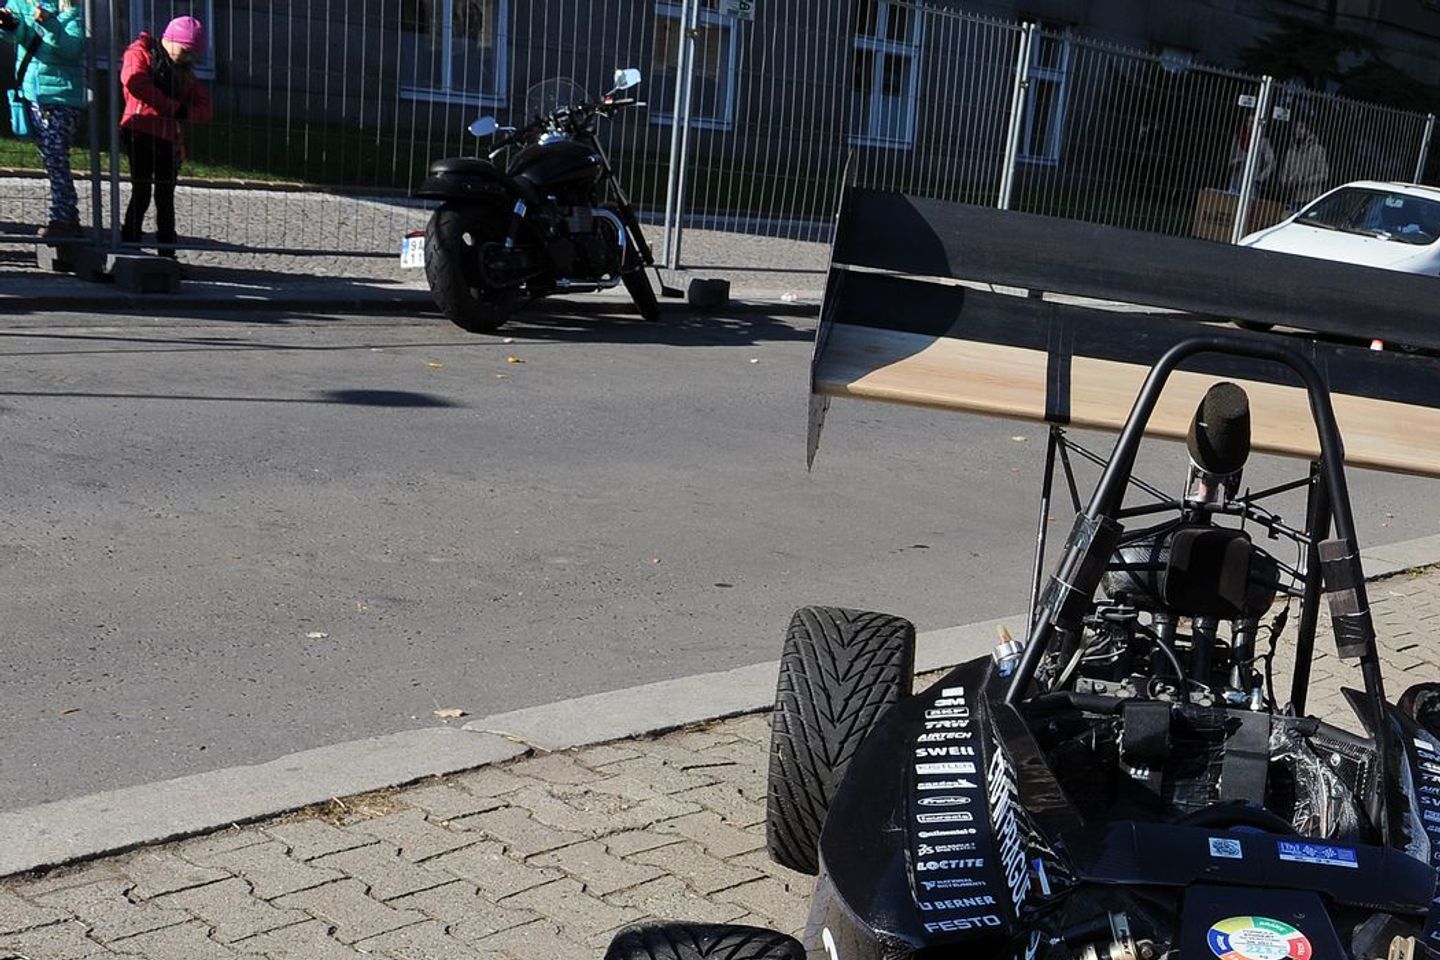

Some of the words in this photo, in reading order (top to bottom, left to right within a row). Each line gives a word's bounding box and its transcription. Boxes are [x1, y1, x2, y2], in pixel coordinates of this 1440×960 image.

[924, 720, 970, 729] TRW
[917, 732, 973, 742] AIRTECH
[917, 858, 984, 871] LOCTITE
[996, 809, 1030, 918] PRAGUE
[934, 895, 997, 910] BERNER
[923, 914, 1001, 933] FESTO
